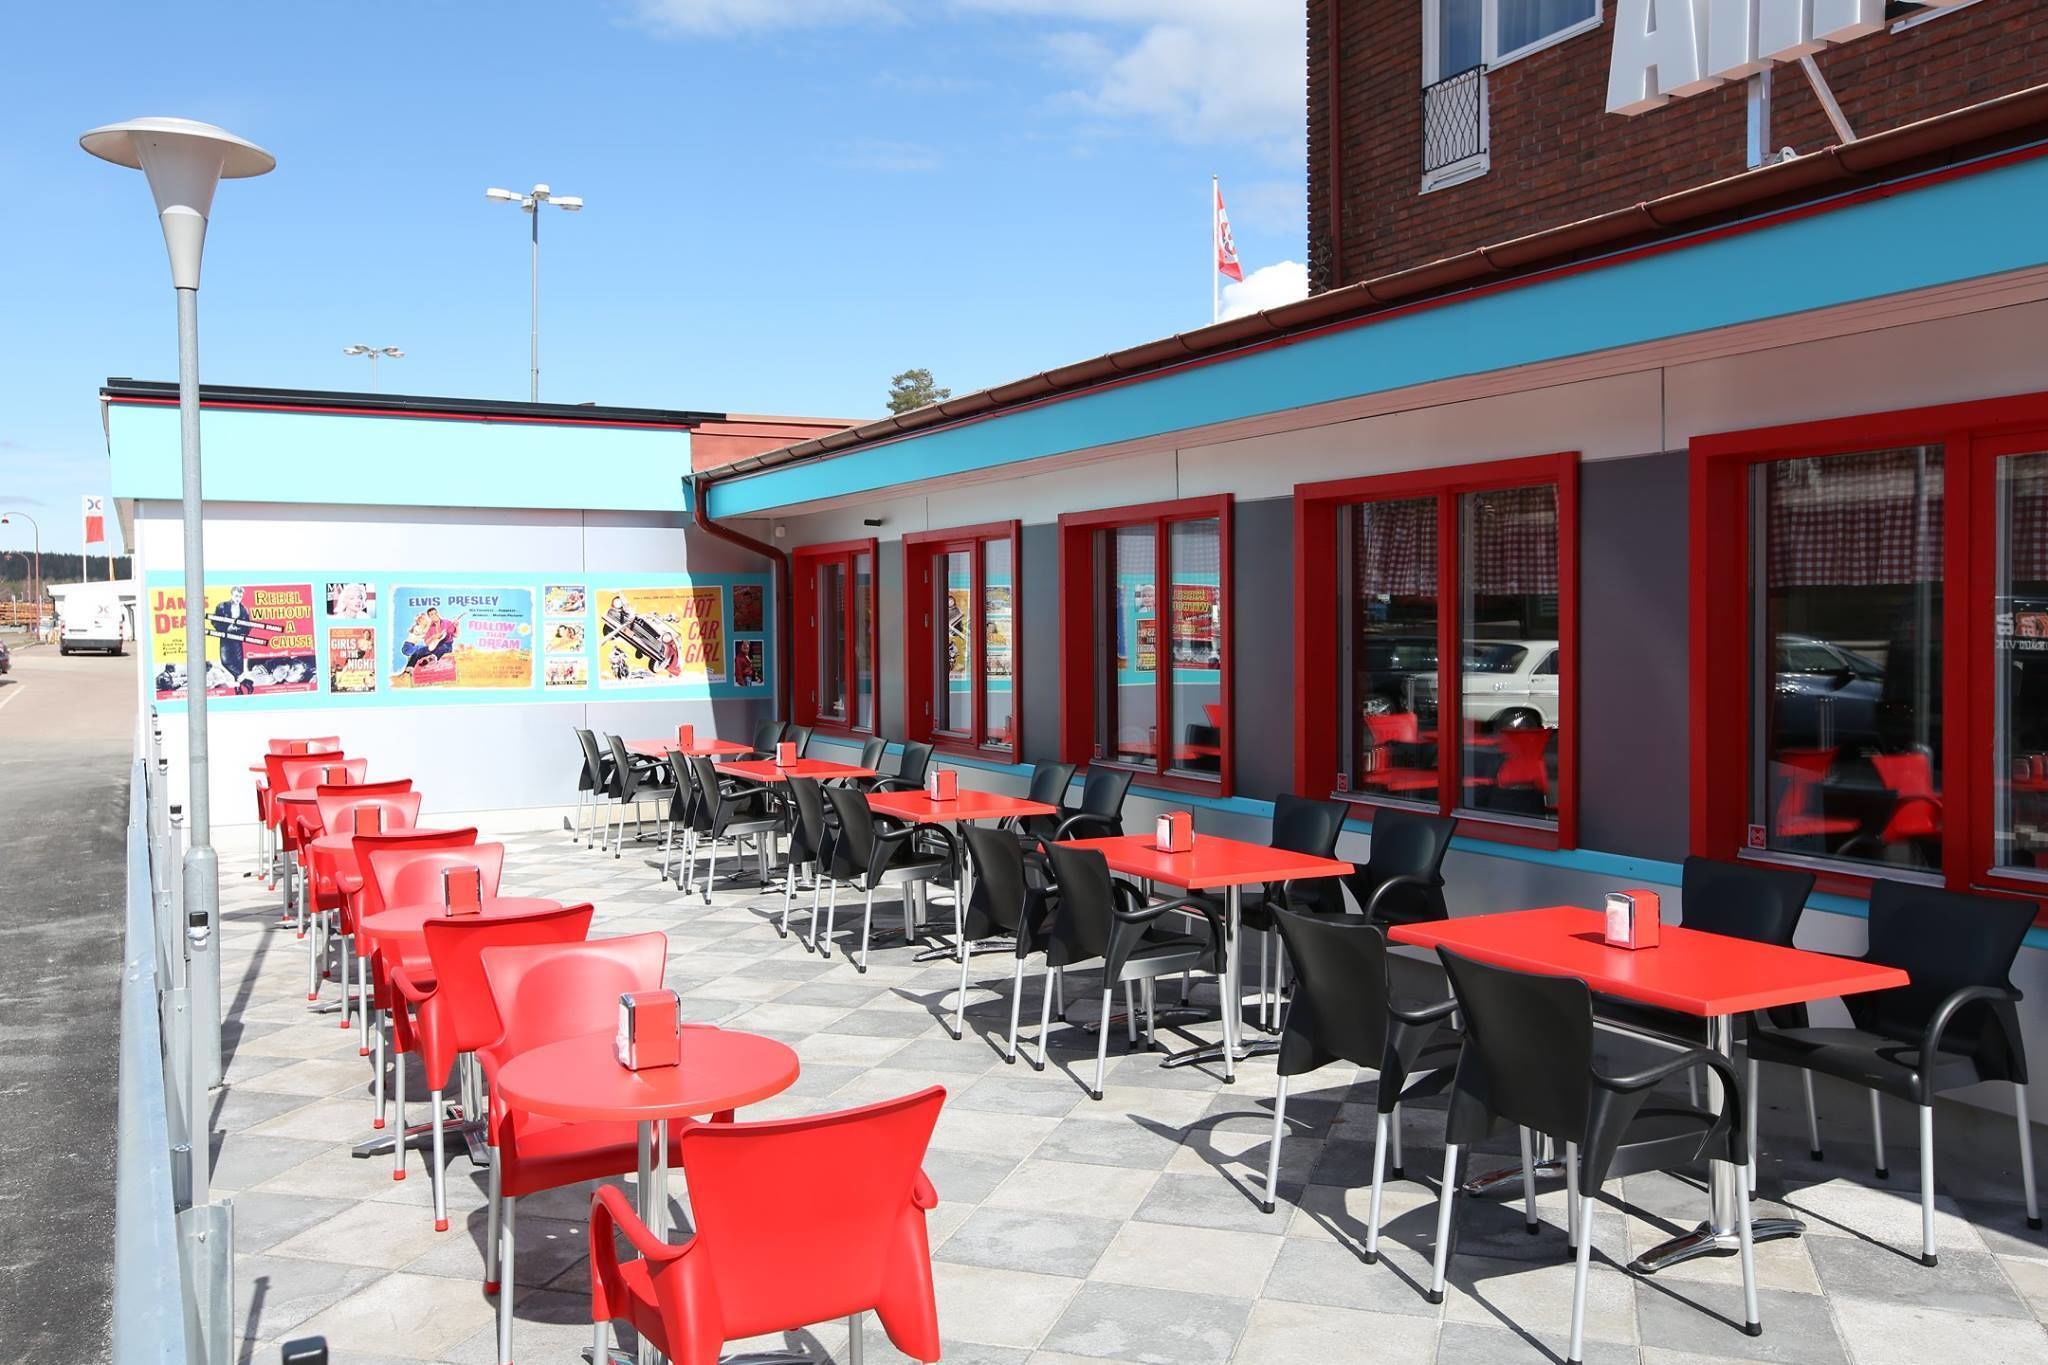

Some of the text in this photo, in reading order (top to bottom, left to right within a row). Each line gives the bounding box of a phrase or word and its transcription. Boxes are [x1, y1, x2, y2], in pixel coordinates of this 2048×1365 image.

[154, 591, 209, 611] JAMS
[255, 590, 303, 607] REBEL
[408, 595, 500, 607] ELVIS PRESLEY
[251, 607, 312, 620] WITHOUT
[684, 598, 716, 618] HOT
[155, 614, 187, 634] DEA
[286, 621, 295, 633] A
[468, 621, 516, 632] FOLLOW
[688, 619, 719, 640] CAR
[270, 635, 313, 649] CAUSE
[331, 638, 356, 650] GIRLS
[478, 638, 521, 650] DREAM
[685, 642, 720, 663] GIRL
[347, 658, 375, 671] NIGHT
